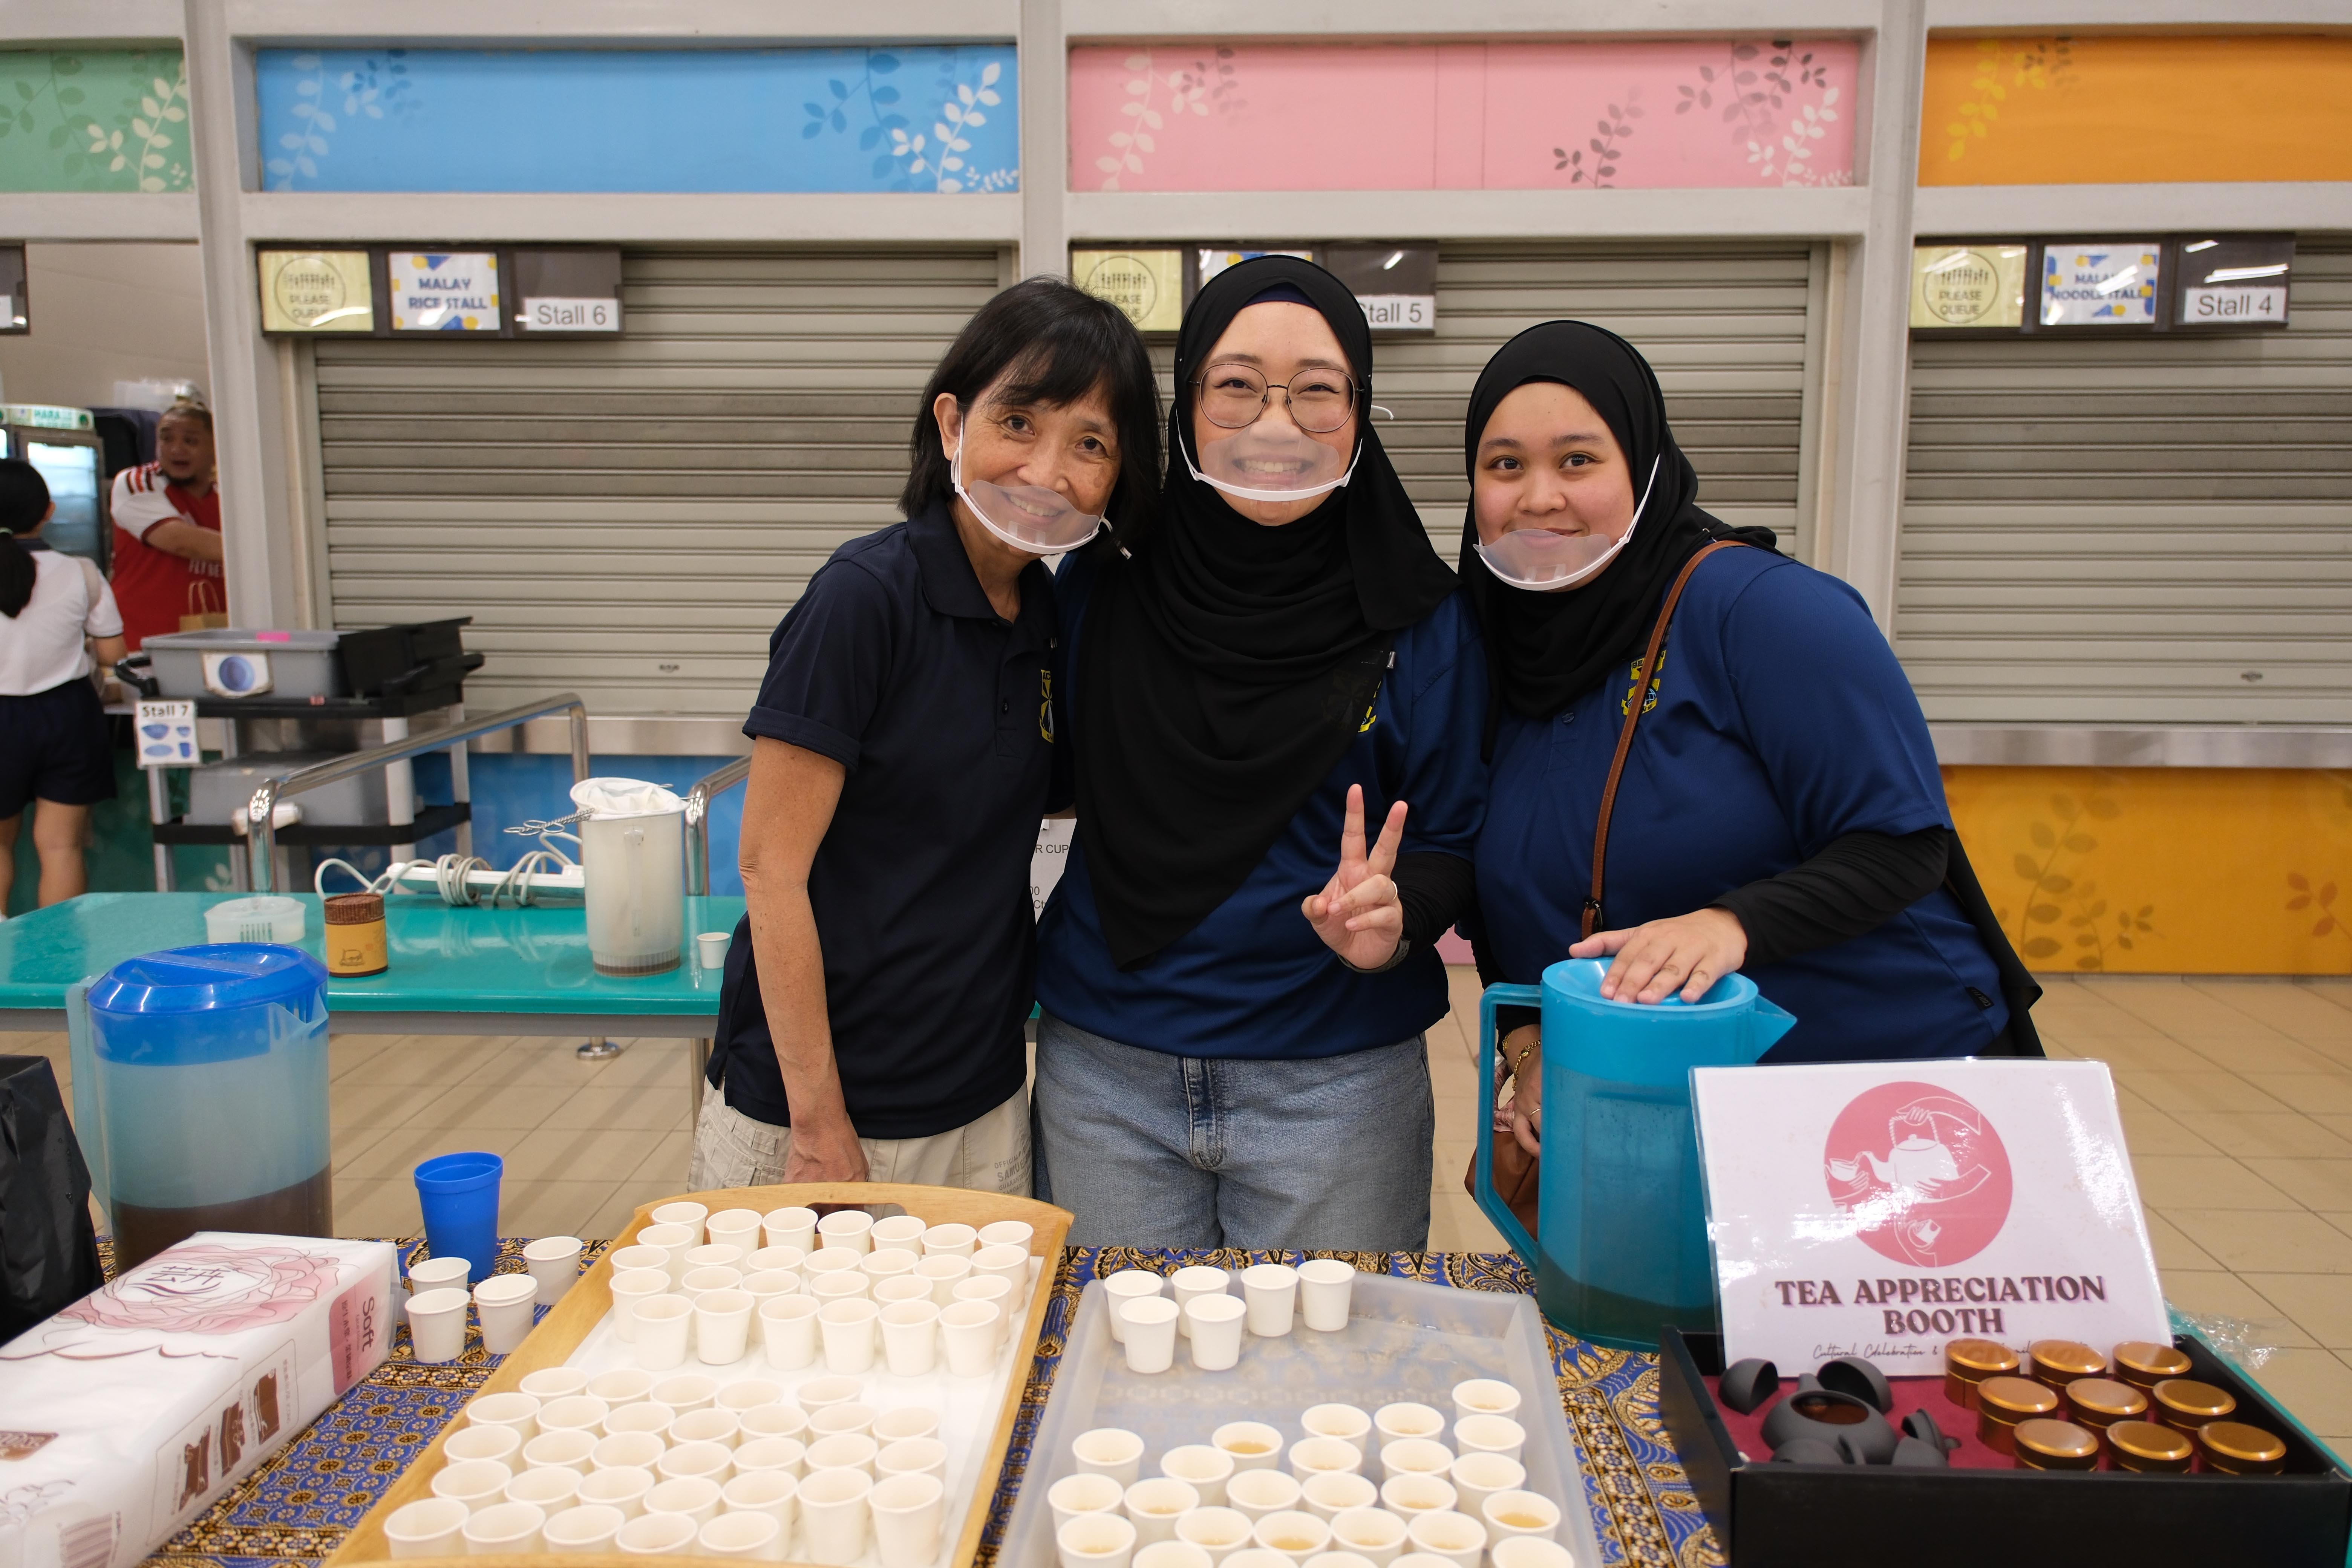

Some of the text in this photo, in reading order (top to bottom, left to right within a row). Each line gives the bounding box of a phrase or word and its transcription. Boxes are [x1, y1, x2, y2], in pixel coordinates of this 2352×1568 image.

[418, 277, 471, 290] MALAY
[2075, 272, 2115, 283] MALA
[1939, 290, 1982, 301] PLEASE
[2198, 294, 2271, 315] Stall 4
[537, 305, 607, 325] Stall 6
[1409, 303, 1422, 323] 5
[142, 704, 188, 718] Stall 7
[1035, 844, 1043, 853] R
[1775, 1276, 2106, 1306] TEA APPRECIATION
[362, 1296, 374, 1352] Soft
[1883, 1308, 2005, 1335] BOOTH
[1813, 1342, 1858, 1359] Cultural
